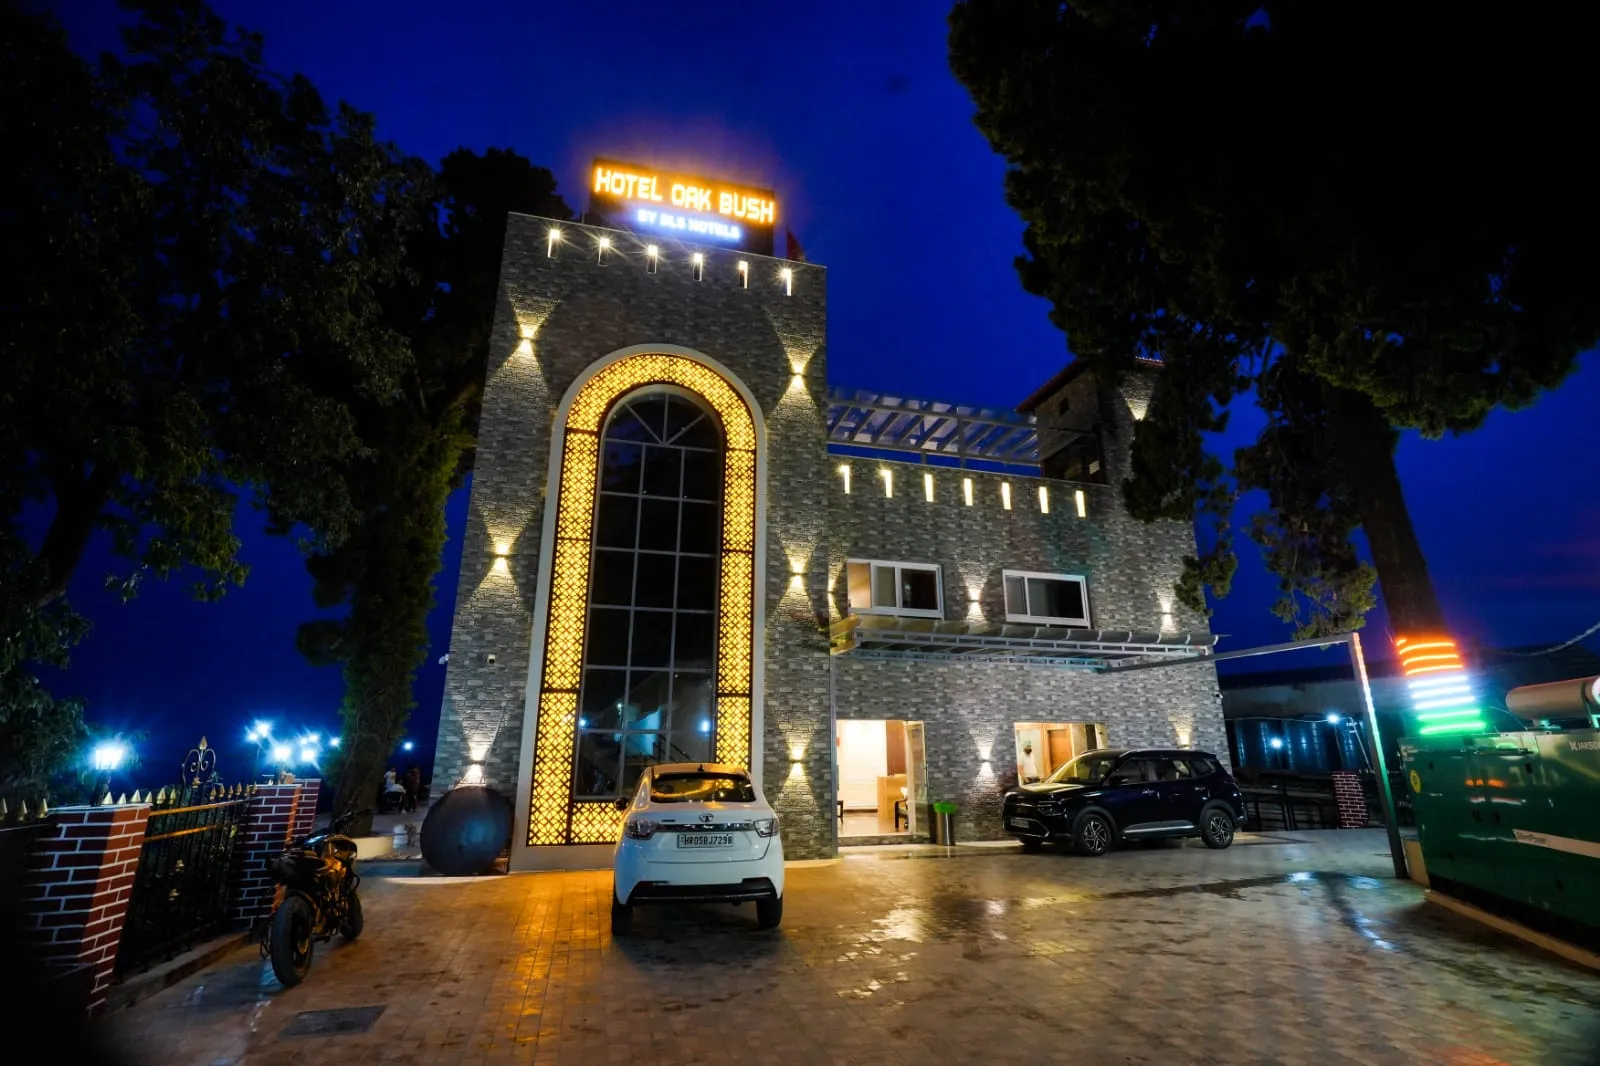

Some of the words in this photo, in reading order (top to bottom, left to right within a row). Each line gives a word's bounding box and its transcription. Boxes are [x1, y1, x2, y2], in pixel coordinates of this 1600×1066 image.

[594, 168, 663, 201] HOTEL
[671, 184, 712, 212] OAK
[719, 192, 775, 223] BUSH
[637, 209, 656, 224] BY
[688, 219, 741, 241] HOTELS
